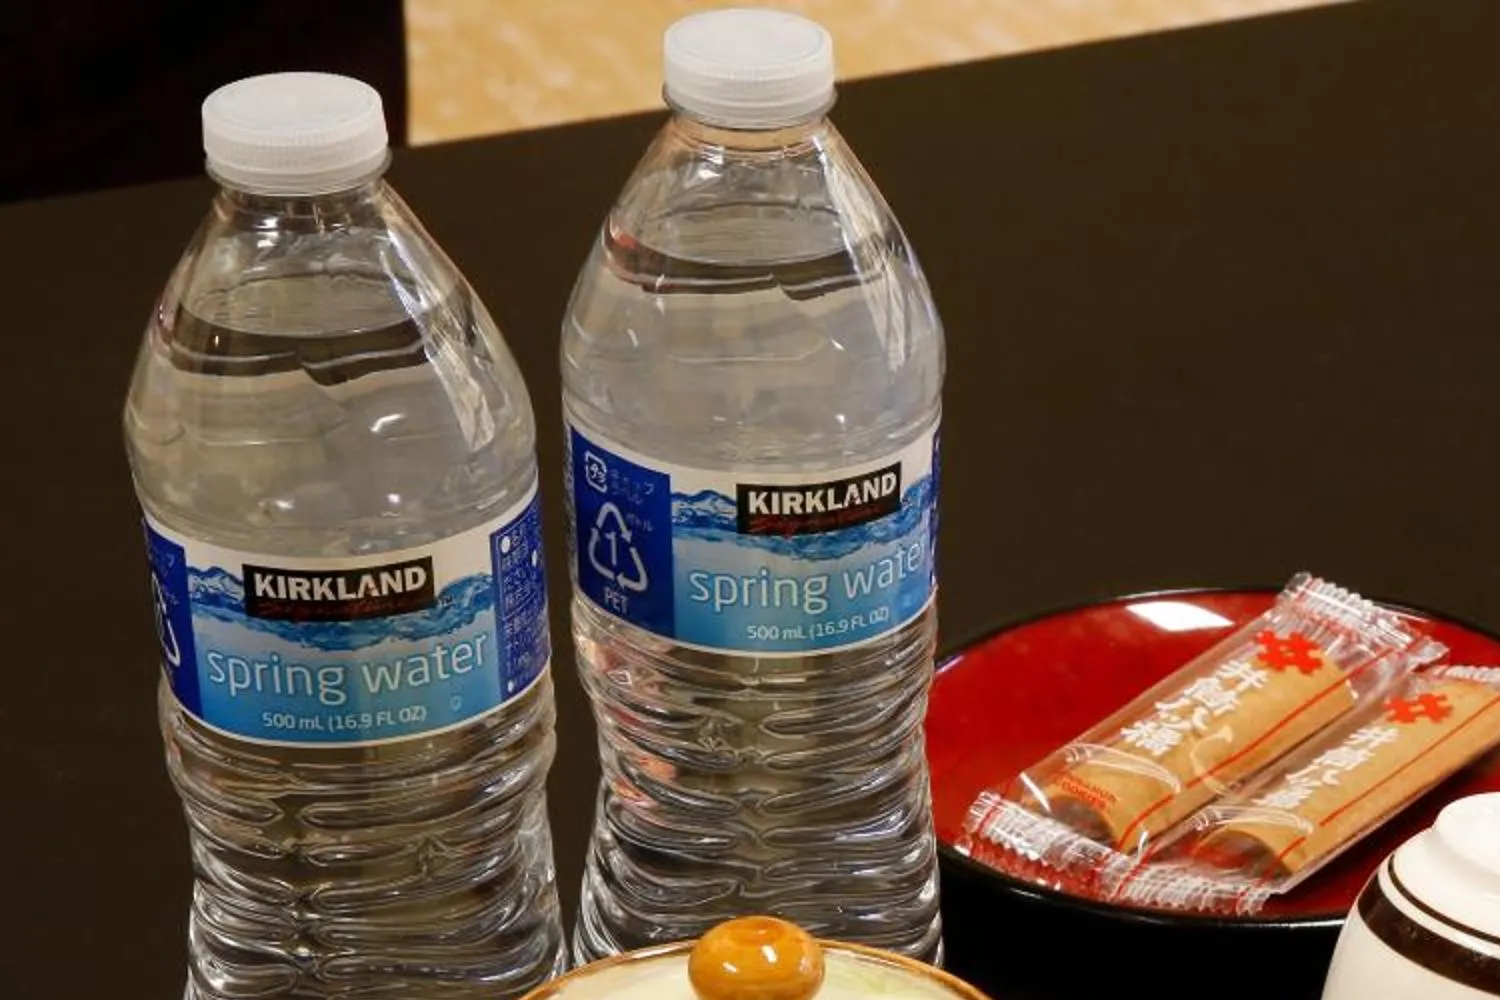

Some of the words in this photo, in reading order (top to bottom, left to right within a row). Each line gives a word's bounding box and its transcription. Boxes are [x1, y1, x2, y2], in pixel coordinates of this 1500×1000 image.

[747, 471, 898, 515] KIRKLAND
[254, 566, 428, 601] KIRKLAND
[604, 587, 628, 614] PET
[690, 567, 828, 615] spring
[746, 624, 779, 641] 500
[809, 619, 849, 641] (16.9
[206, 649, 346, 706] spring
[361, 631, 490, 693] water
[262, 711, 296, 730] 500
[328, 713, 373, 733] (16.9
[376, 711, 397, 726] FL
